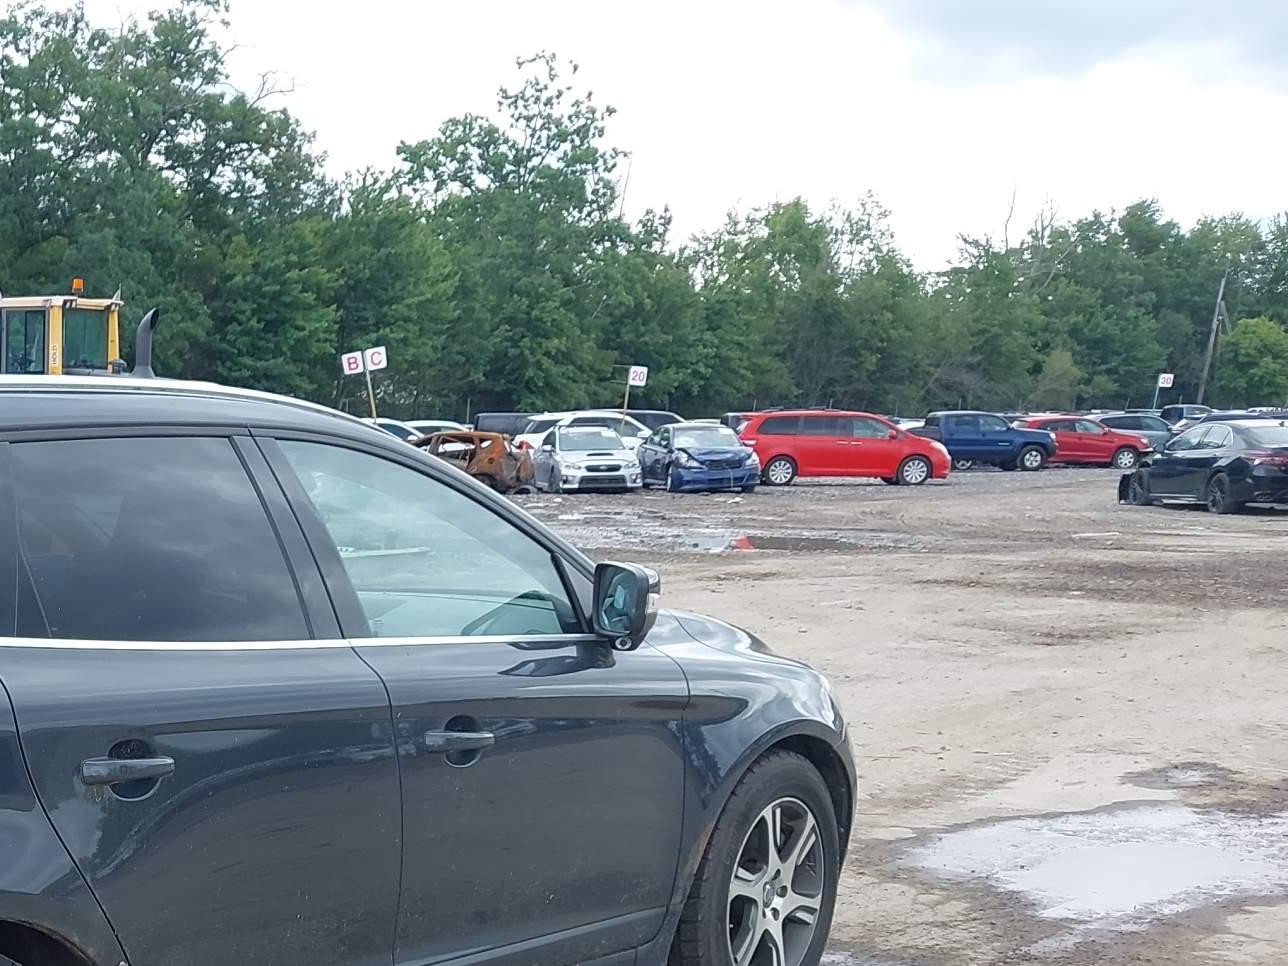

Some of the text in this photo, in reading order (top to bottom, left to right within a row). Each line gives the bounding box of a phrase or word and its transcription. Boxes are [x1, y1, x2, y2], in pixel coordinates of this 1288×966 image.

[346, 356, 359, 371] B
[370, 351, 383, 366] C
[631, 370, 645, 382] 20
